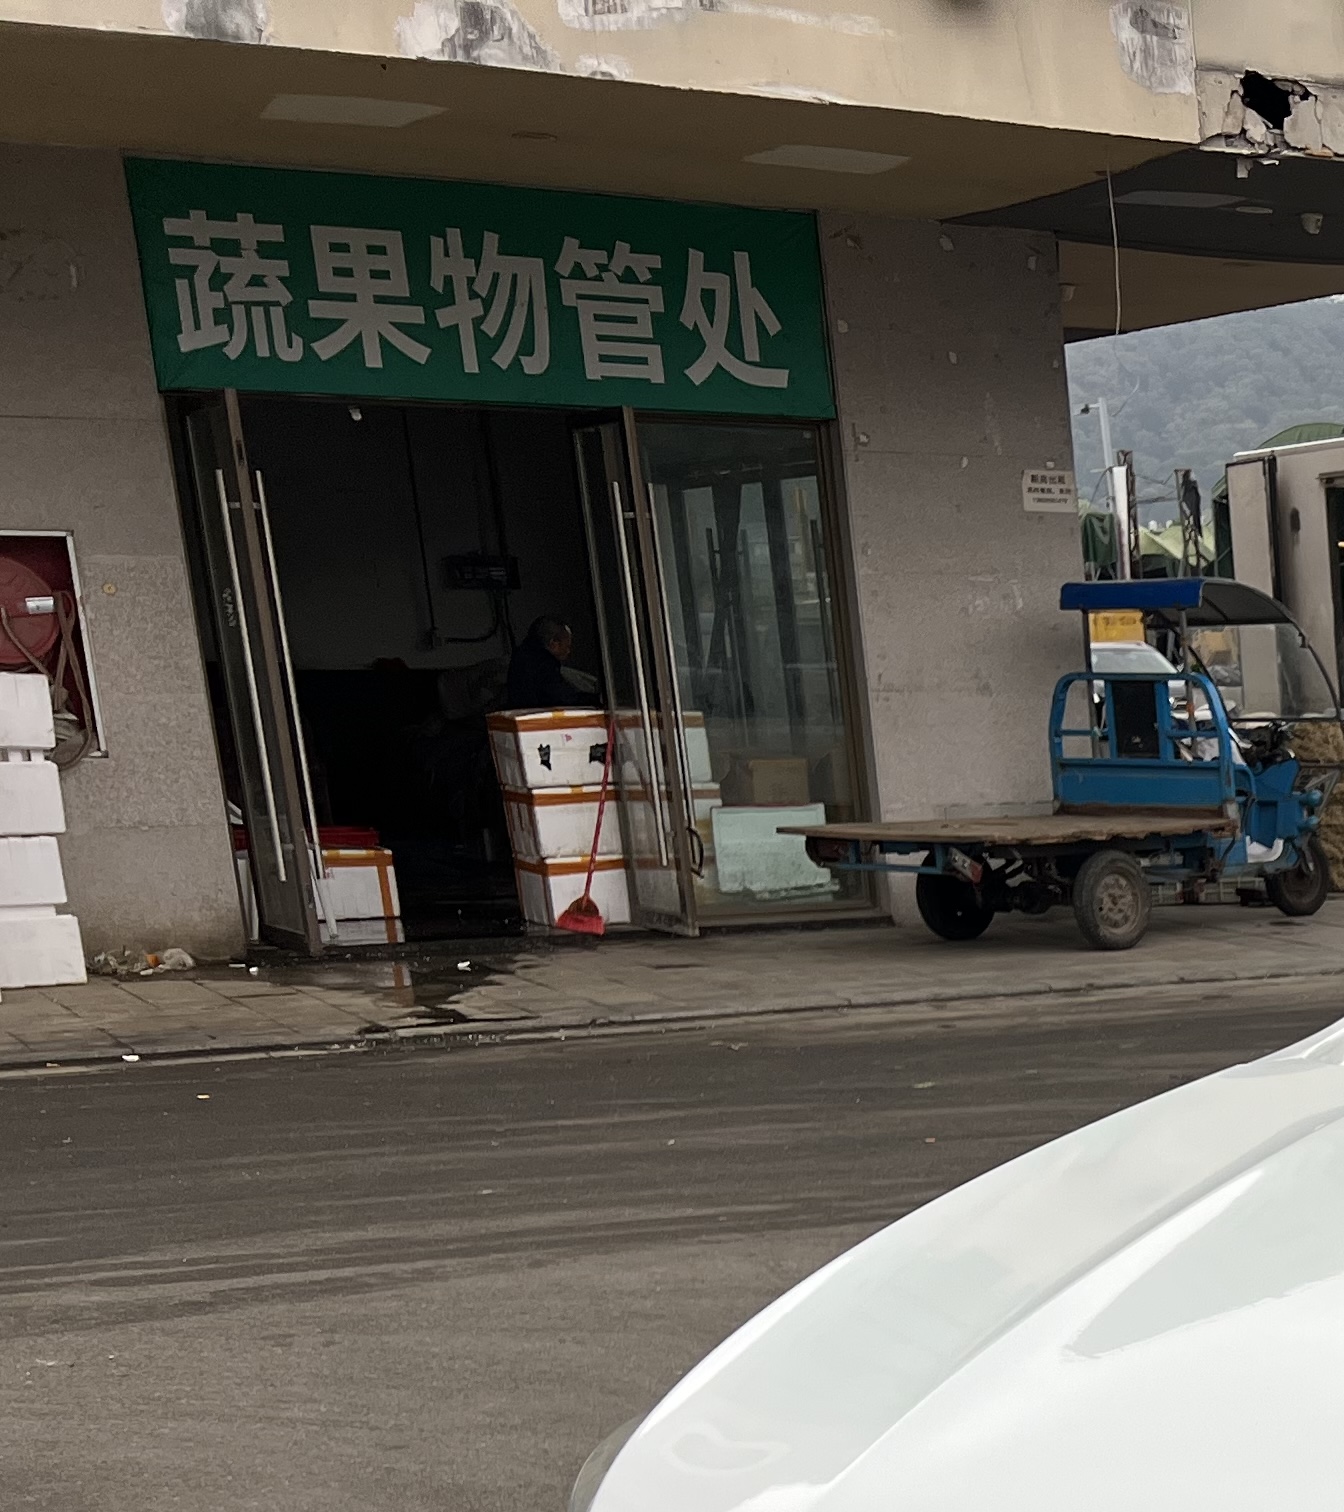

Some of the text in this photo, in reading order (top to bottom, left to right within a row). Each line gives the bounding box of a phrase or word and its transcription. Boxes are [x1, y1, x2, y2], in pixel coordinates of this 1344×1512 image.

[162, 208, 791, 389] 蔬果物管处
